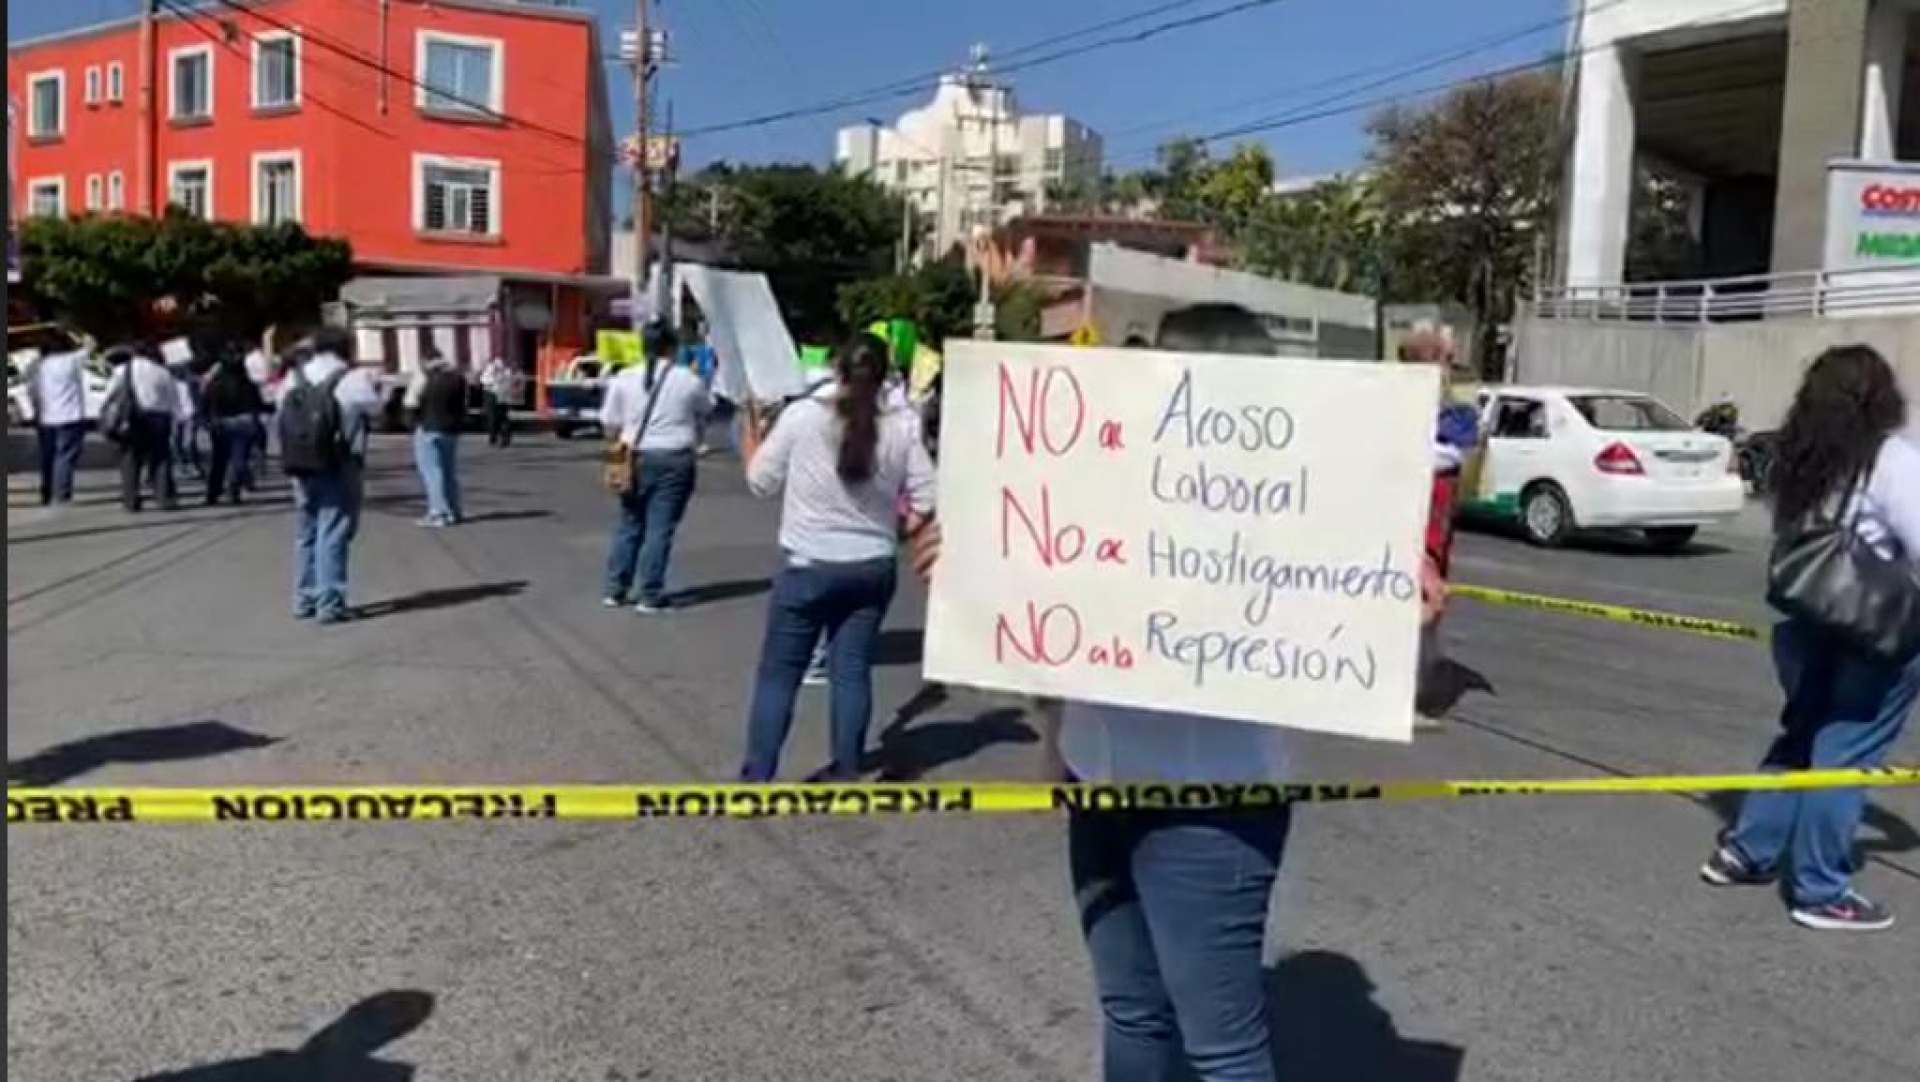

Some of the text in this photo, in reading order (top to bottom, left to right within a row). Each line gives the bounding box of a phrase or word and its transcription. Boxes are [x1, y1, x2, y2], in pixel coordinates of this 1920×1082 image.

[997, 362, 1085, 458] NO
[1152, 368, 1294, 451] Acoso
[1151, 456, 1307, 515] Laboral
[1149, 531, 1415, 624] Hostigamiento
[996, 602, 1080, 665] NO
[1146, 611, 1376, 691] Represión
[212, 795, 557, 822] PRECAUCION
[636, 789, 974, 819] PRECAUCION
